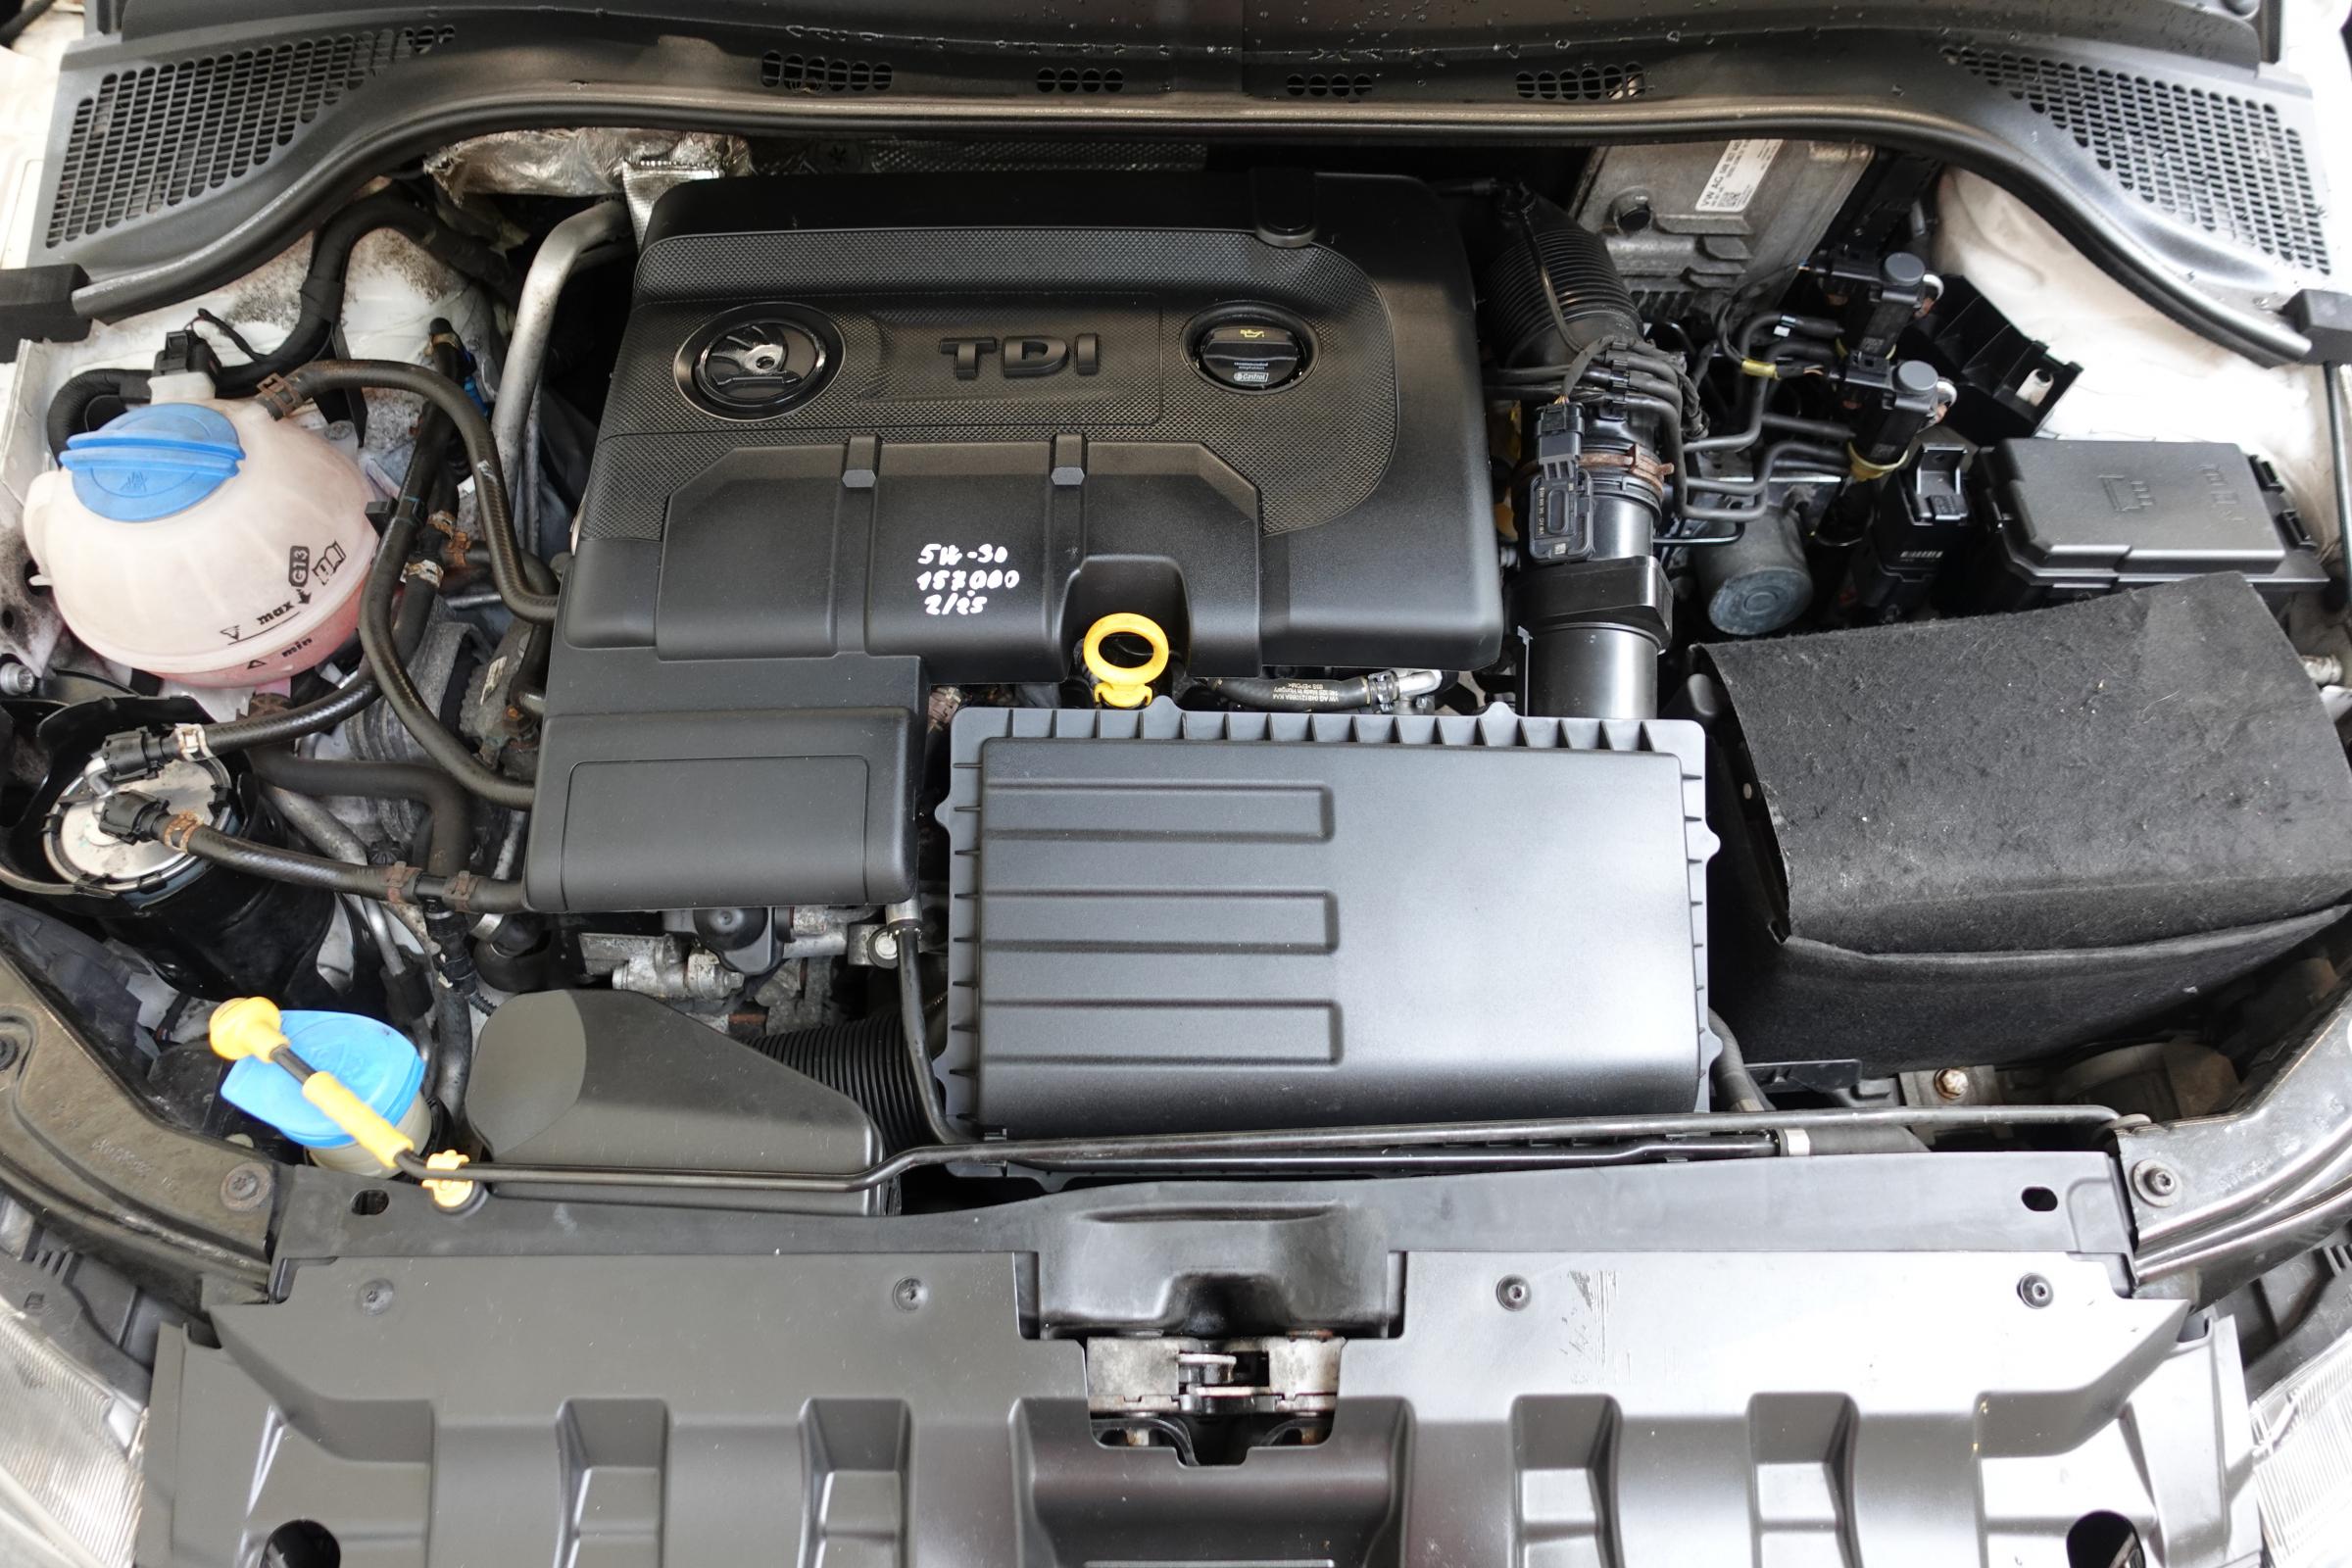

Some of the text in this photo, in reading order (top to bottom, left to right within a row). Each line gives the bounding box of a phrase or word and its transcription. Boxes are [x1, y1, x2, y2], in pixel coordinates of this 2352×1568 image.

[938, 333, 1102, 380] TDI
[1242, 372, 1266, 381] Castrol
[291, 548, 309, 584] G13
[256, 601, 295, 625] max
[281, 638, 313, 658] min
